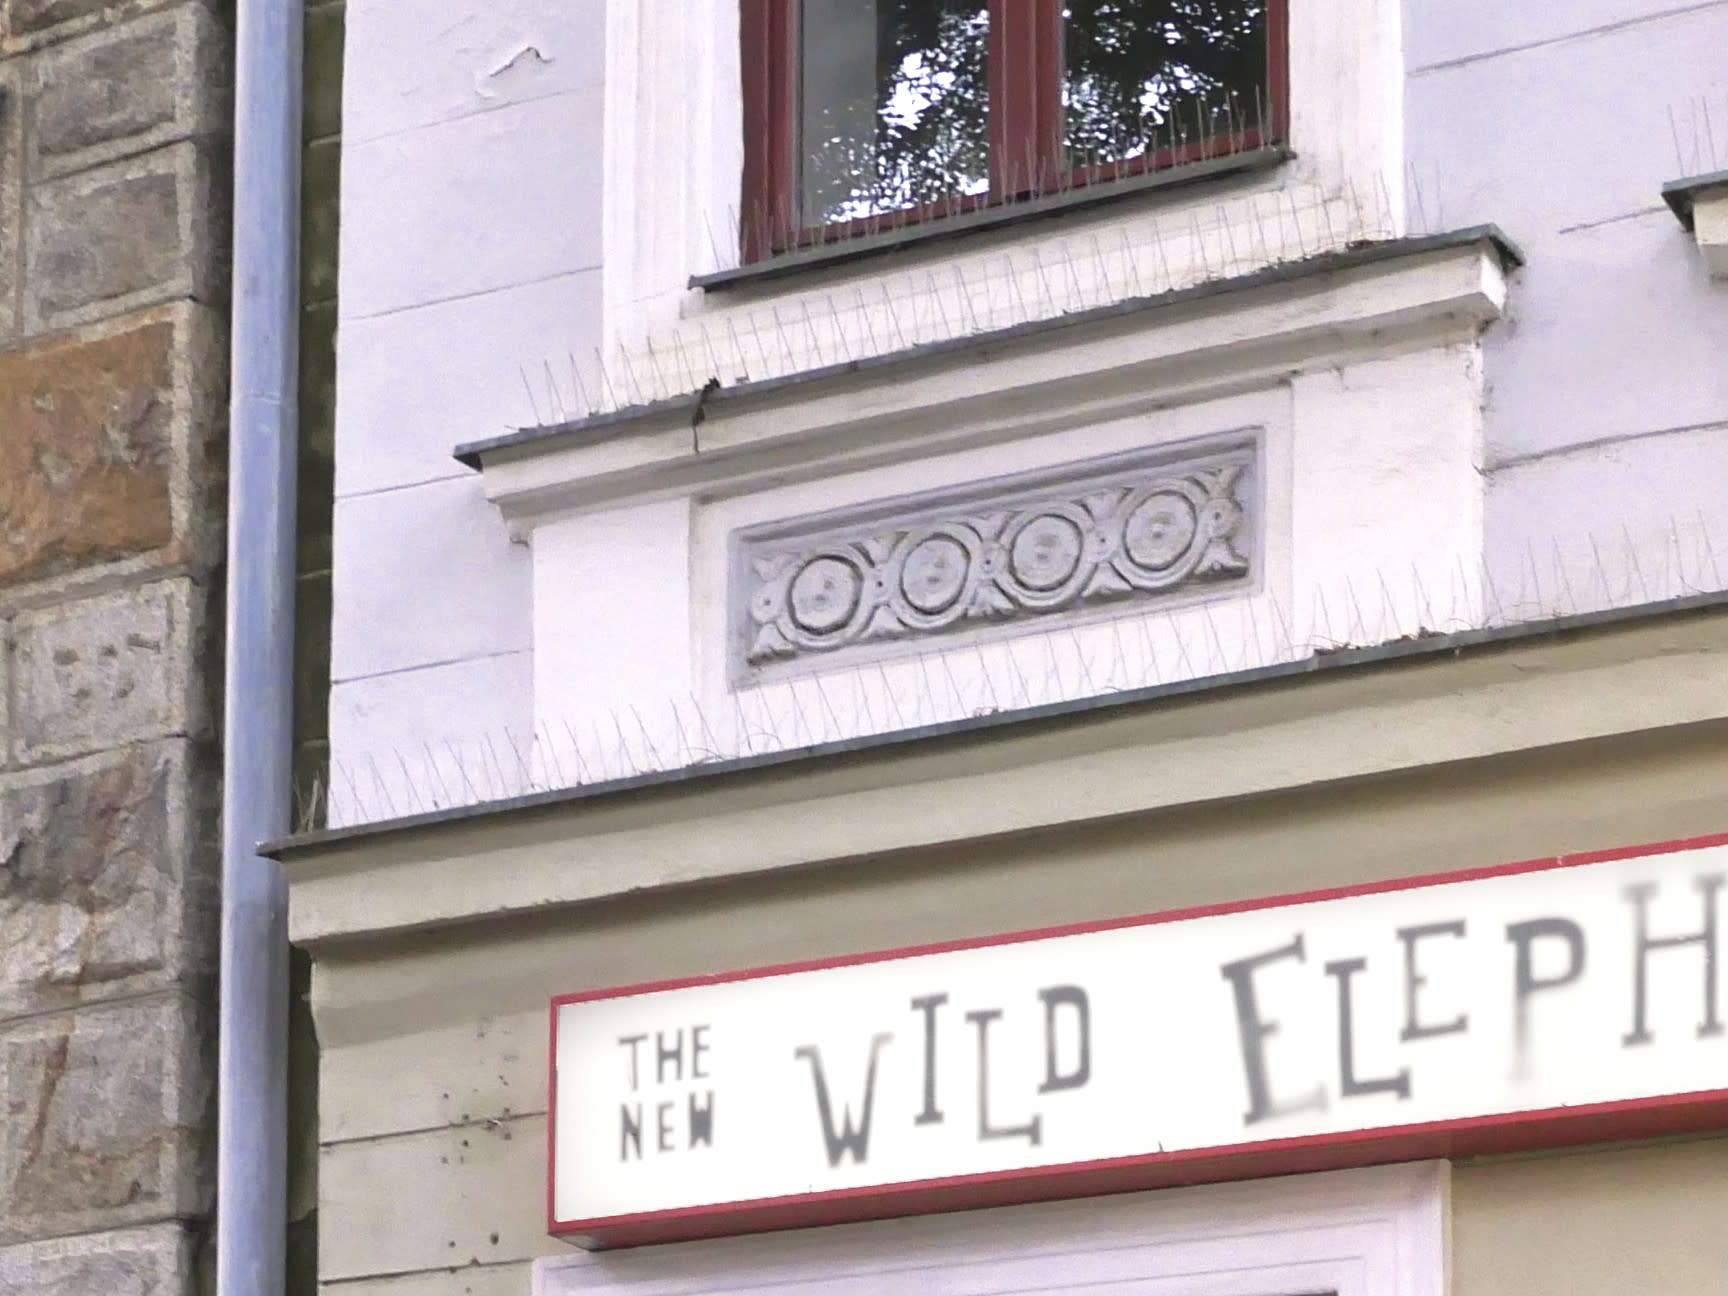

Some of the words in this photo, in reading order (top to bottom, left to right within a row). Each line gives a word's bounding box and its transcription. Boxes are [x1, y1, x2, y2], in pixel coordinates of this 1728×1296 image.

[616, 1024, 712, 1092] THE
[793, 984, 1093, 1168] WILD
[619, 1090, 715, 1162] NEW
